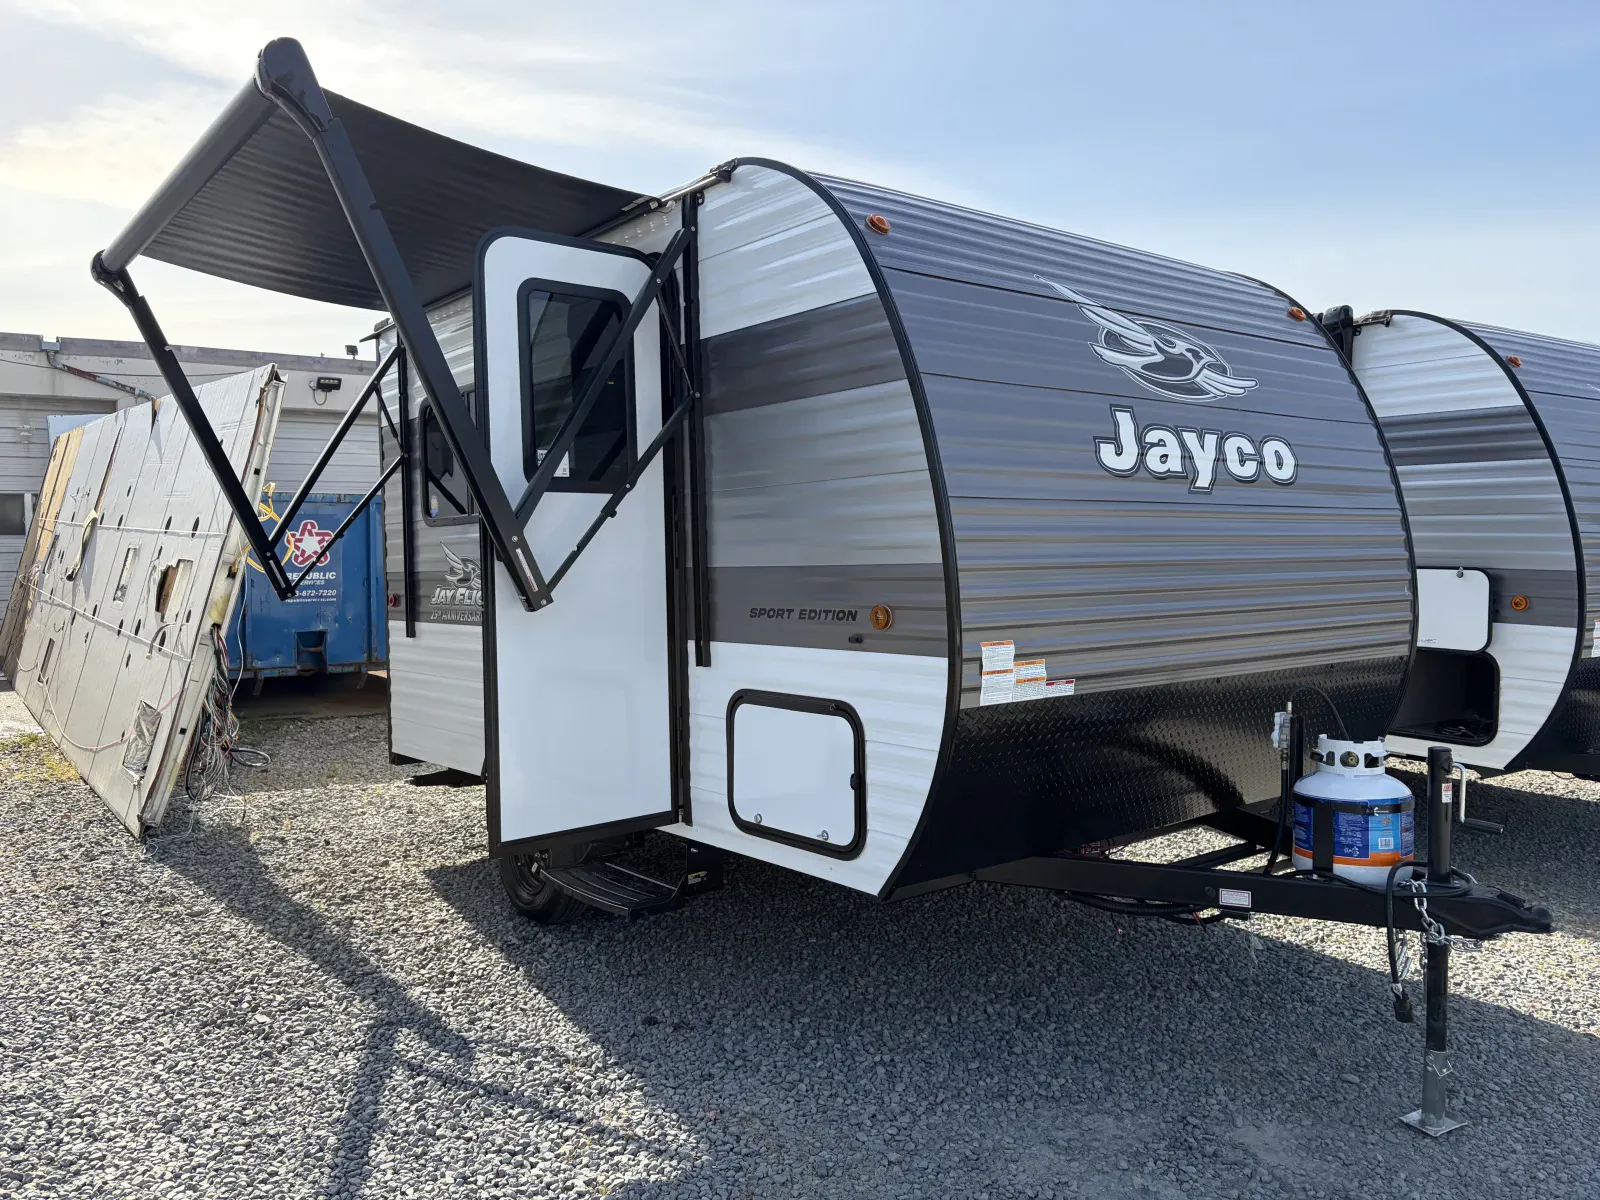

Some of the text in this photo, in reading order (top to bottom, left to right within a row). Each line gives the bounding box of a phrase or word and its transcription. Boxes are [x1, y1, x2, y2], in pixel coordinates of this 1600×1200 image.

[1094, 405, 1298, 494] Jayco
[286, 572, 337, 580] REUBLIC
[430, 586, 456, 605] JAY
[441, 610, 482, 622] ANNIVERSAR
[749, 607, 858, 622] SPORT EDITION
